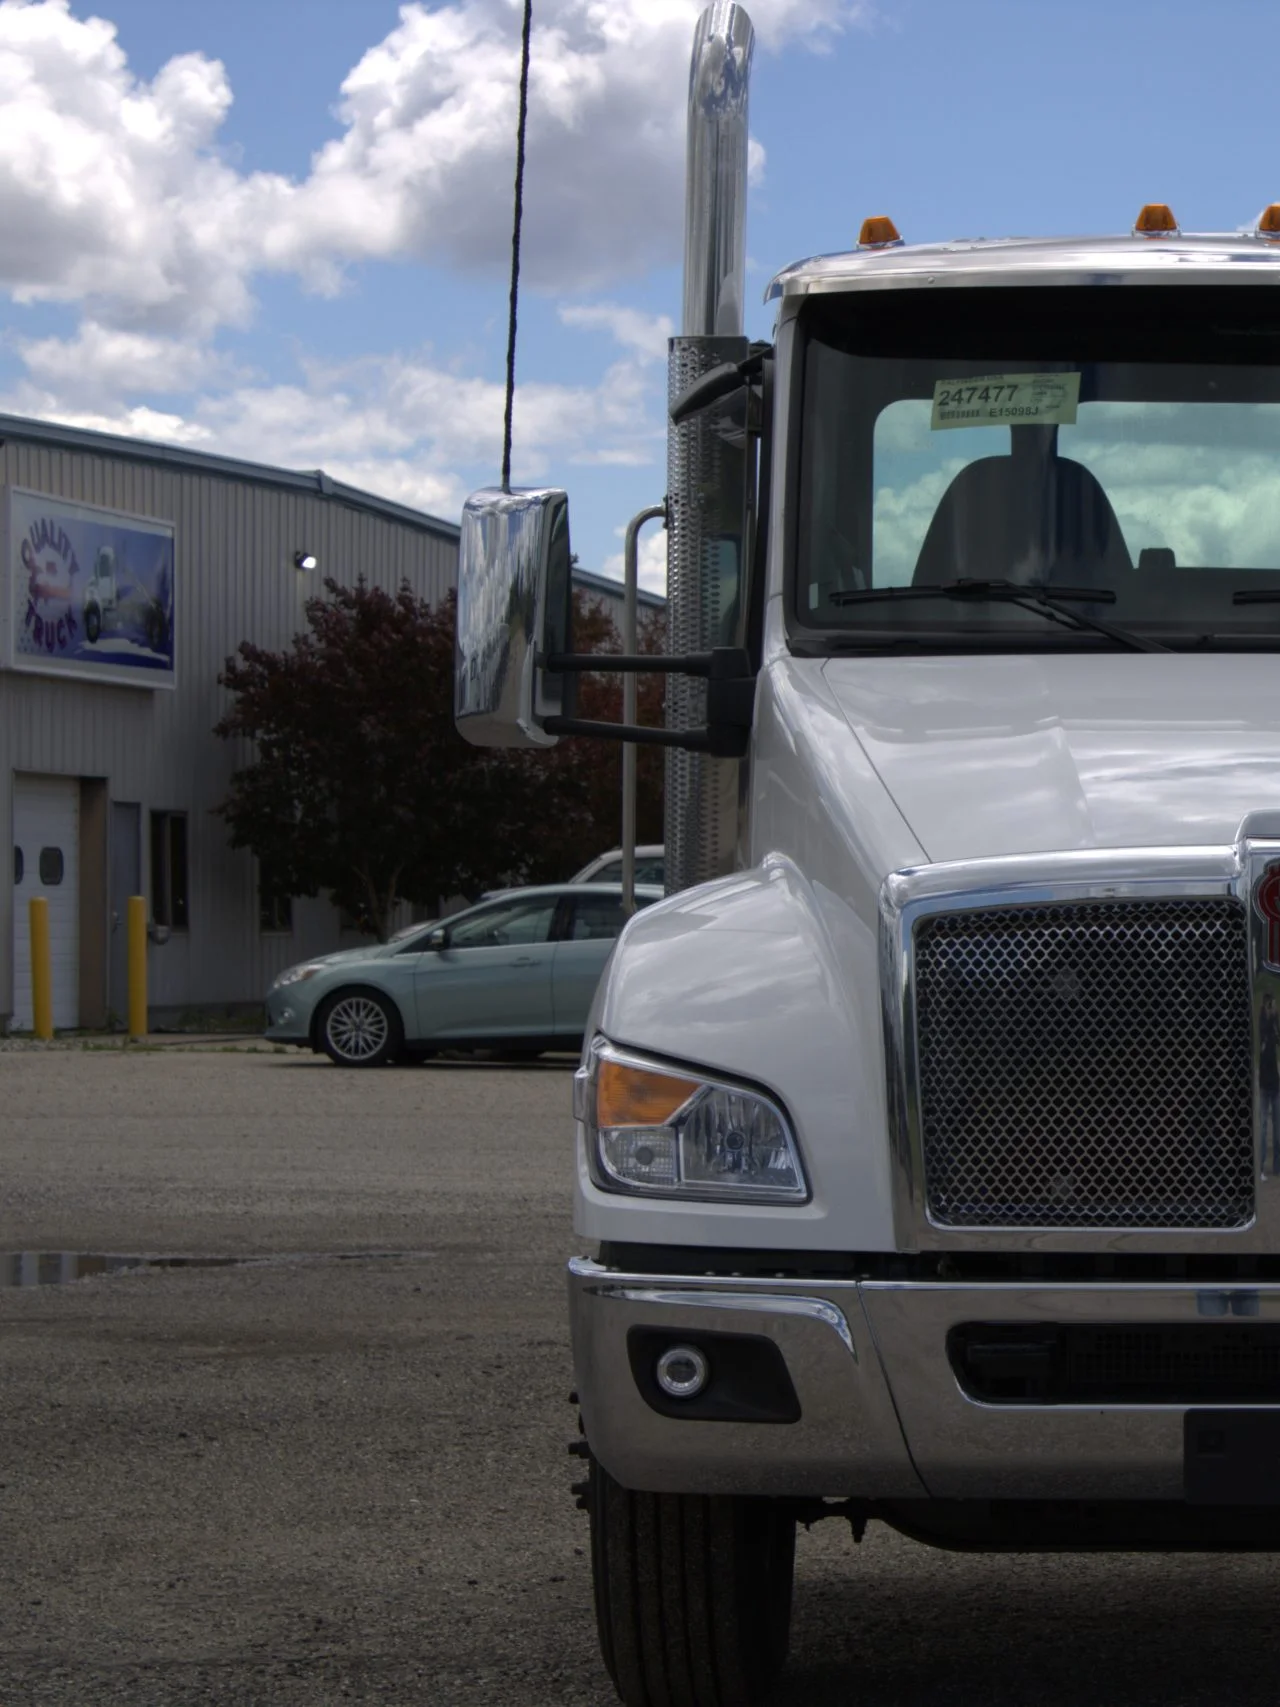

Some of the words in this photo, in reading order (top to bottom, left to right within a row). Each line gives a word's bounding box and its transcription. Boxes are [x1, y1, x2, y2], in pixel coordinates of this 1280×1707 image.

[939, 385, 1019, 407] 247477
[21, 517, 80, 576] QUALITY
[25, 598, 78, 653] TRUCK
